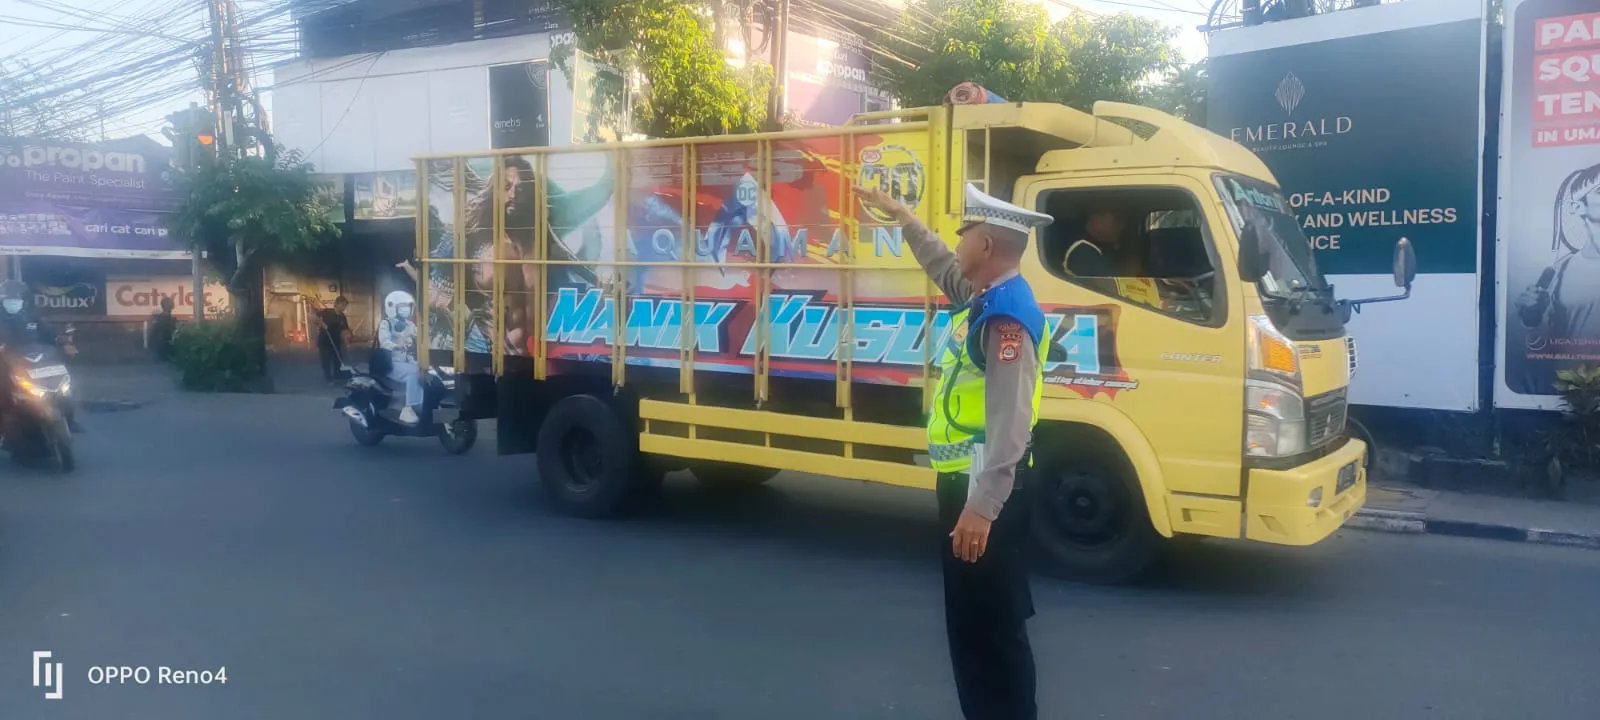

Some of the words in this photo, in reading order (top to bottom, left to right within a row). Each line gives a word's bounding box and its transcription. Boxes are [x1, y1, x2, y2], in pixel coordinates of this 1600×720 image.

[1231, 116, 1352, 142] EMERALD
[1537, 129, 1558, 143] IN
[23, 145, 146, 173] propan
[25, 170, 50, 182] The
[54, 173, 85, 185] Paint
[91, 175, 145, 190] Specialist
[1303, 213, 1344, 229] AND
[1348, 208, 1457, 227] WELLNESS
[111, 224, 131, 235] cat
[35, 294, 88, 308] Dulux
[545, 287, 736, 352] MANIK
